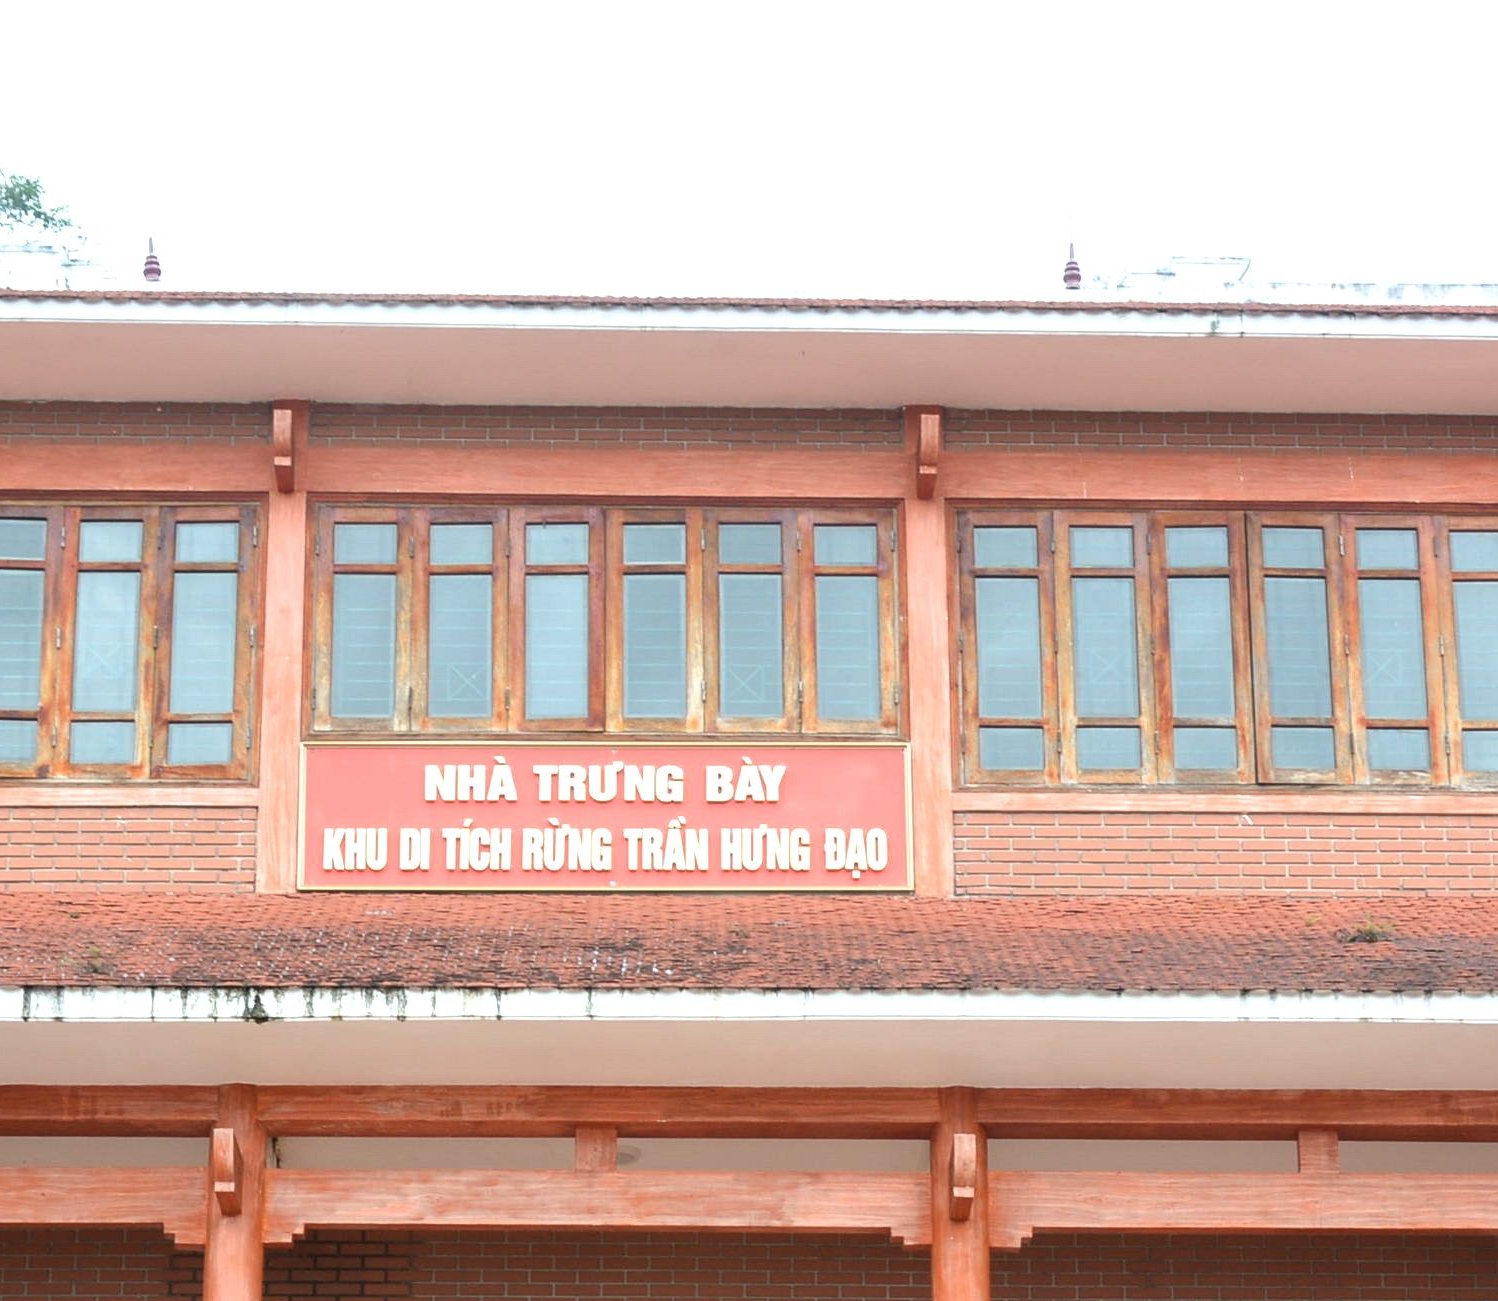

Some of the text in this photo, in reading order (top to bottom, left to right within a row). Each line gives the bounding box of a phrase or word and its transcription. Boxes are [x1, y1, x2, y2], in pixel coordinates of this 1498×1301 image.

[424, 756, 787, 803] NHÀ TRƯNG BÀY
[323, 815, 888, 880] KHU DI TÍCH RỪNG TRẦN HƯNG ĐẠO
